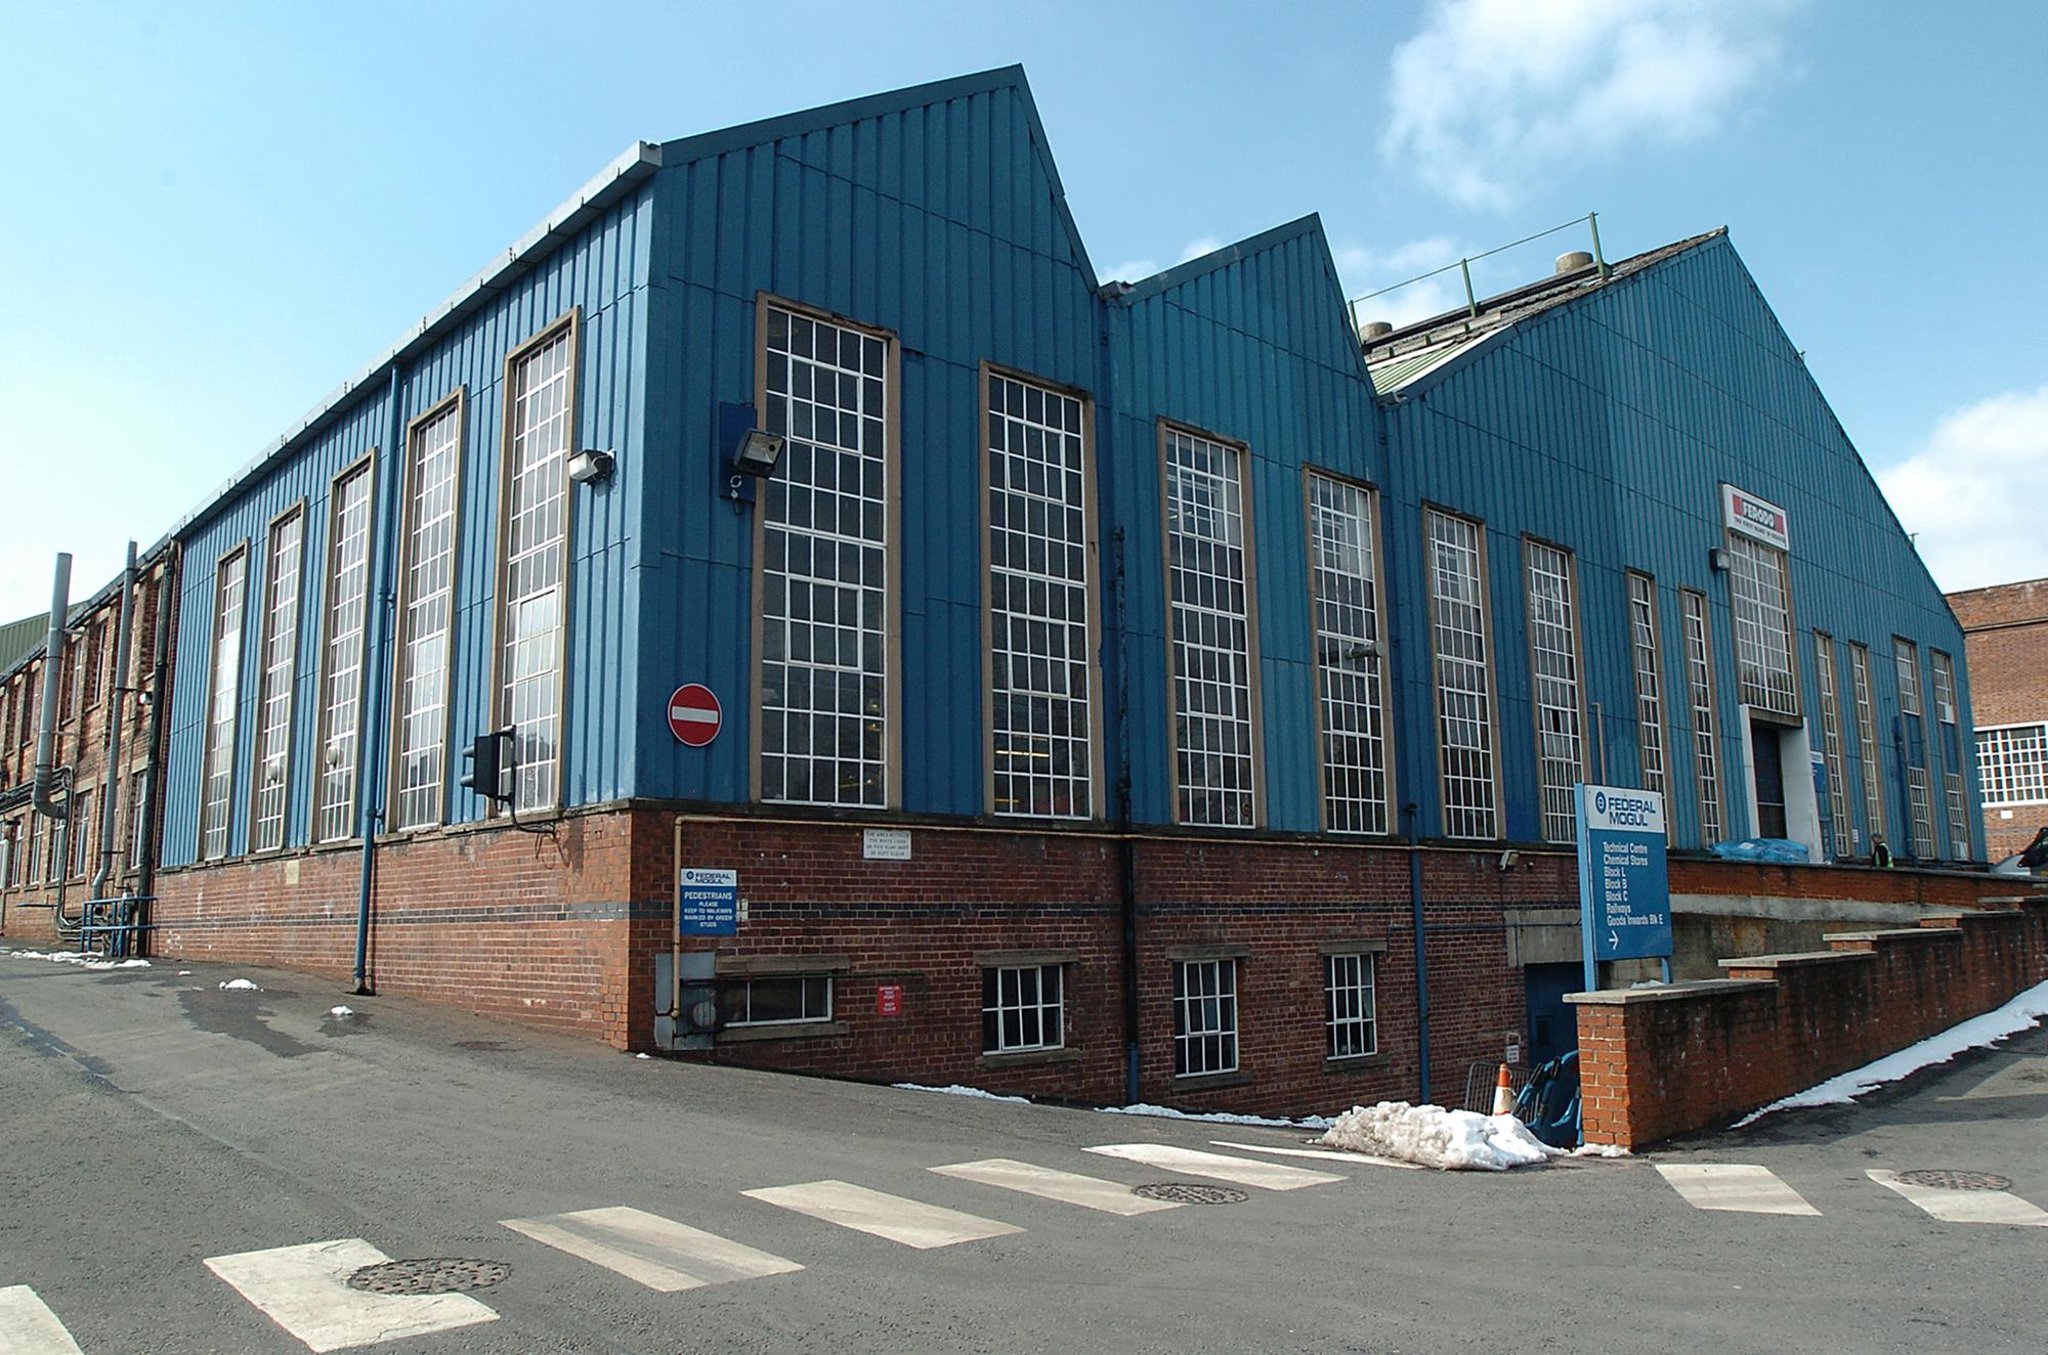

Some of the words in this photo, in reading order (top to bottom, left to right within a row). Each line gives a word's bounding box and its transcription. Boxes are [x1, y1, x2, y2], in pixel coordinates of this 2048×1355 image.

[1743, 501, 1775, 528] FERODO
[1608, 797, 1656, 814] FEDERAL
[1609, 811, 1648, 827] MOGUL
[1603, 841, 1629, 853] Technical
[1630, 843, 1648, 854] Centre
[1603, 854, 1629, 865] Chemical
[1630, 855, 1648, 866] Stores
[1604, 866, 1620, 877] Block
[1621, 867, 1626, 877] L
[1604, 878, 1621, 889] Block
[1622, 878, 1627, 889] B
[684, 892, 732, 900] PEDESTRIANS
[1605, 890, 1622, 902] Block
[1622, 890, 1628, 901] C
[1606, 903, 1631, 916] Railways
[1607, 915, 1626, 926] Goods
[1627, 915, 1649, 925] Inwards
[1649, 914, 1658, 925] Blk
[1658, 914, 1663, 925] E
